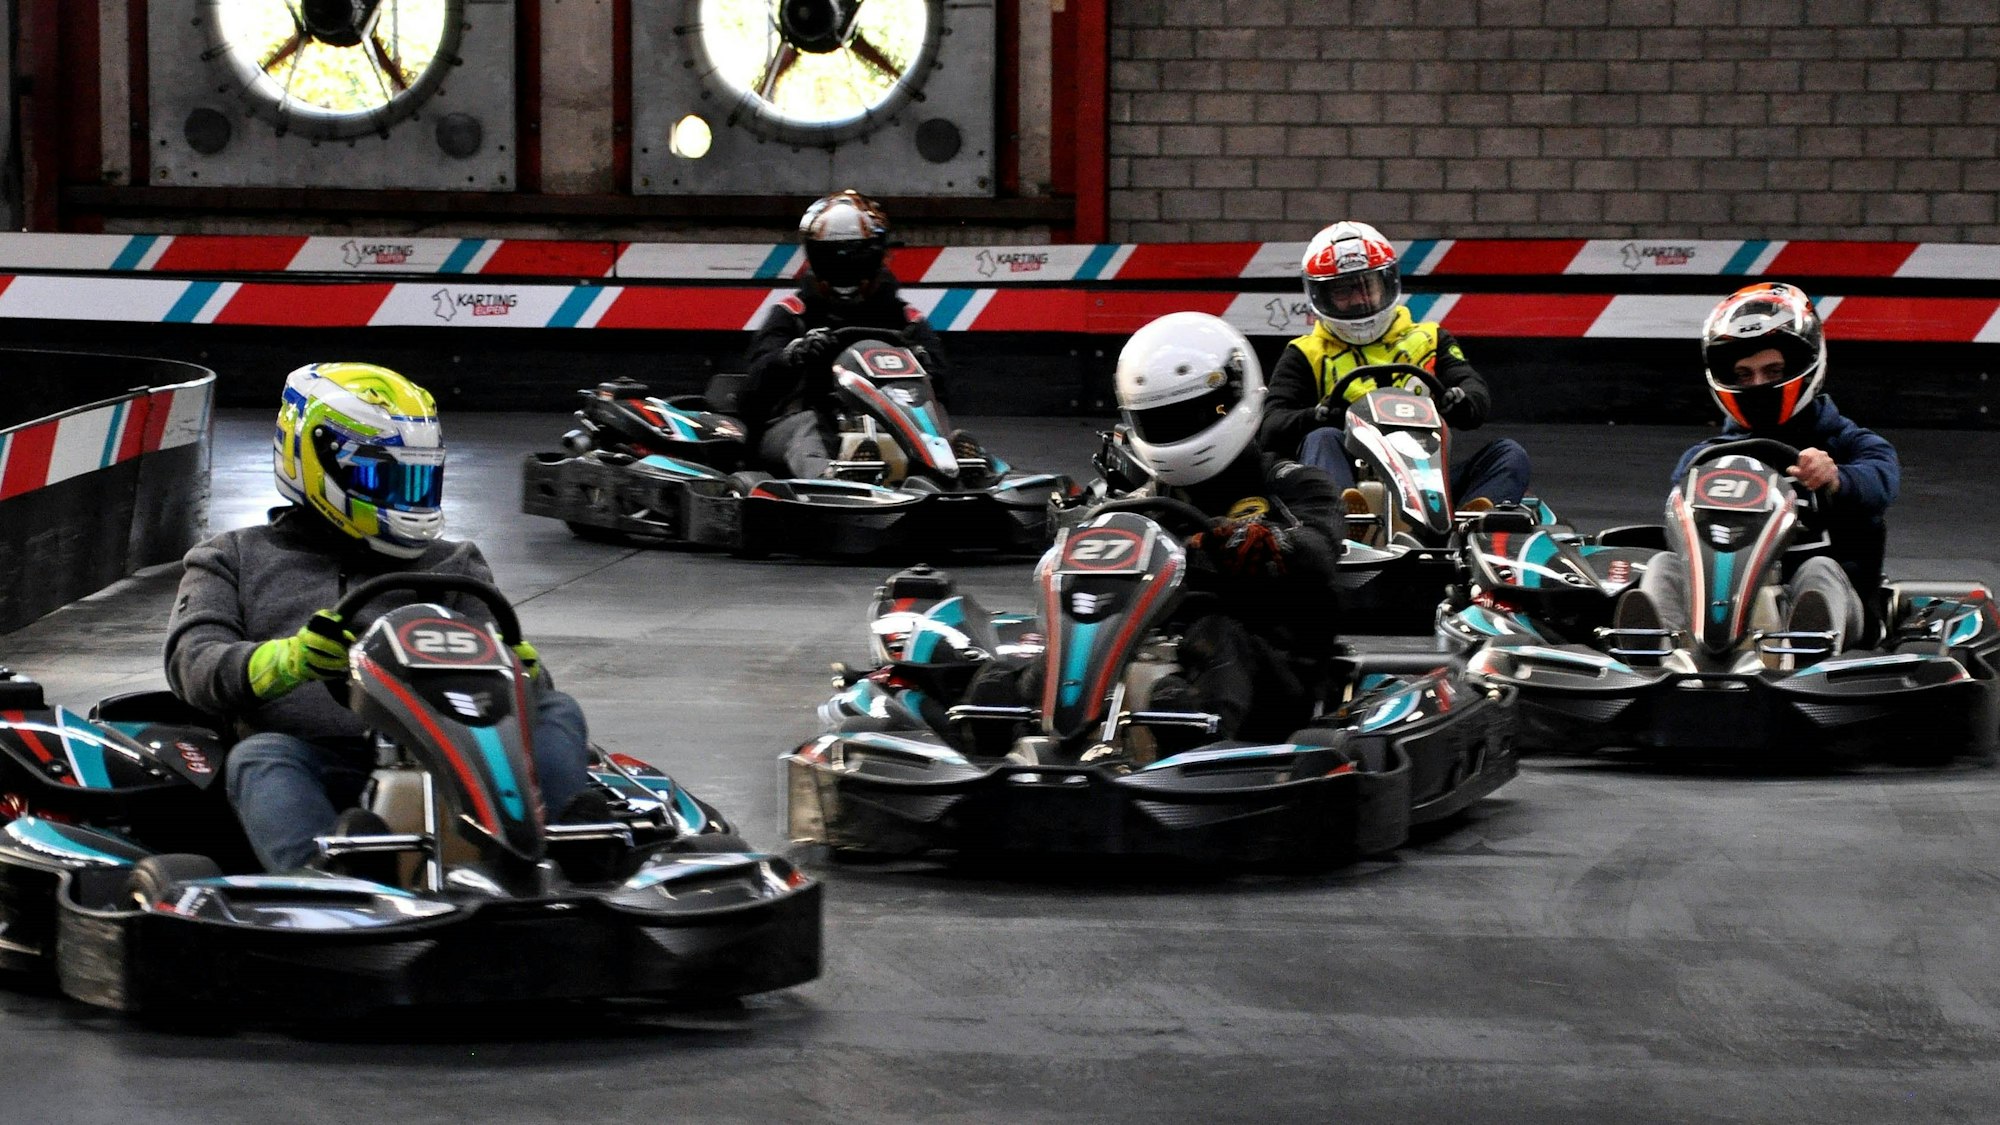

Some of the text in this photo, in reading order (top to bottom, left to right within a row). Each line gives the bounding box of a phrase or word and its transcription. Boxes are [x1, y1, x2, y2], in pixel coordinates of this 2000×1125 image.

[362, 245, 413, 256] KARTING
[997, 253, 1048, 264] KARTING
[457, 294, 517, 307] KARTING
[874, 355, 904, 369] 19
[1395, 403, 1415, 417] 8
[1707, 479, 1750, 498] 21
[1069, 540, 1136, 560] 27
[413, 630, 479, 653] 25
